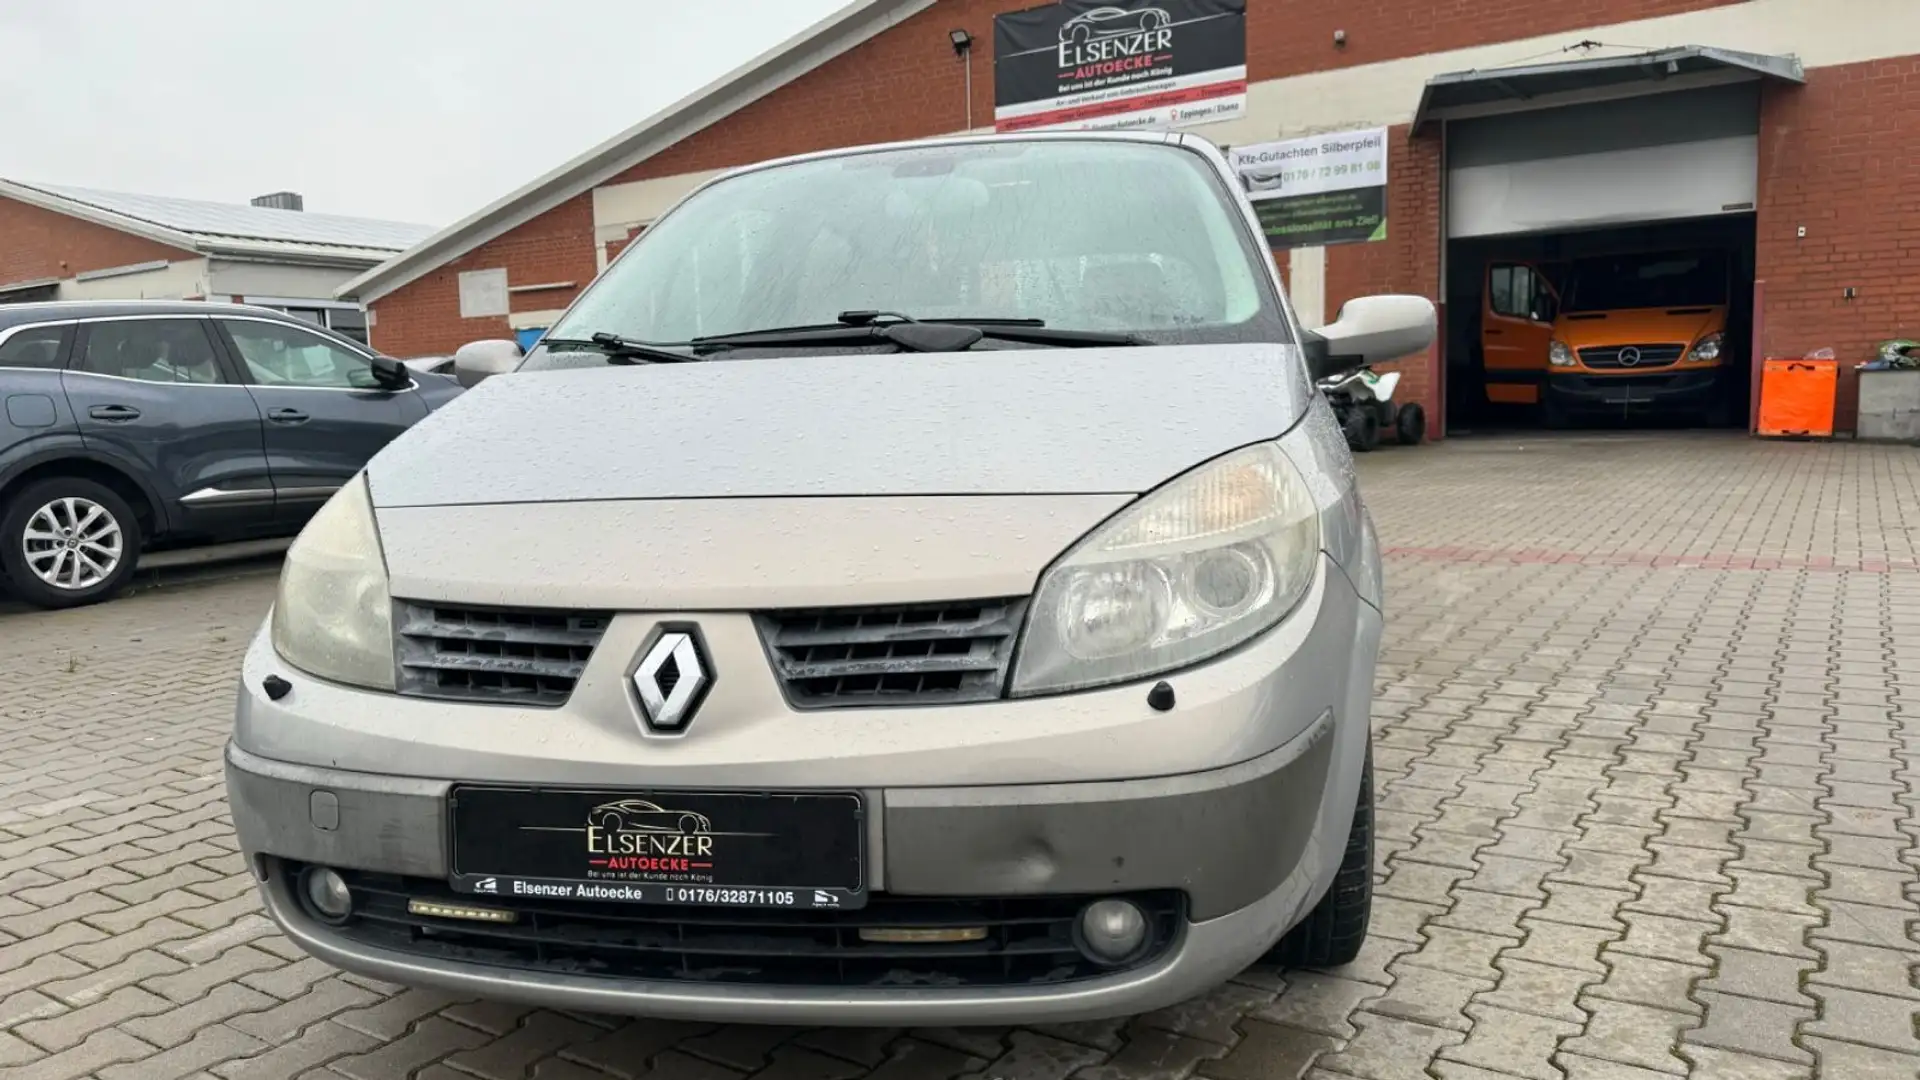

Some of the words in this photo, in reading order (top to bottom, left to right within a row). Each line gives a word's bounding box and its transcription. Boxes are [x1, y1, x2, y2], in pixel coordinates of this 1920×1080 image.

[1058, 28, 1173, 68] ELSENZER
[1075, 54, 1153, 79] AUTOECKE
[1180, 107, 1212, 119] Eppingen
[1238, 147, 1318, 165] Kfz-Gutachten
[1321, 136, 1381, 154] Silberpfeil
[587, 825, 713, 856] ELSENZER
[587, 870, 599, 878] Bei
[602, 871, 616, 879] uns
[617, 871, 627, 879] ist
[629, 871, 640, 879] der
[643, 872, 669, 880] Kunde
[607, 856, 689, 871] AUTOECKE
[513, 880, 573, 897] Elsenzer
[576, 883, 643, 900] Autoecke
[678, 888, 795, 905] 0176/32871105
